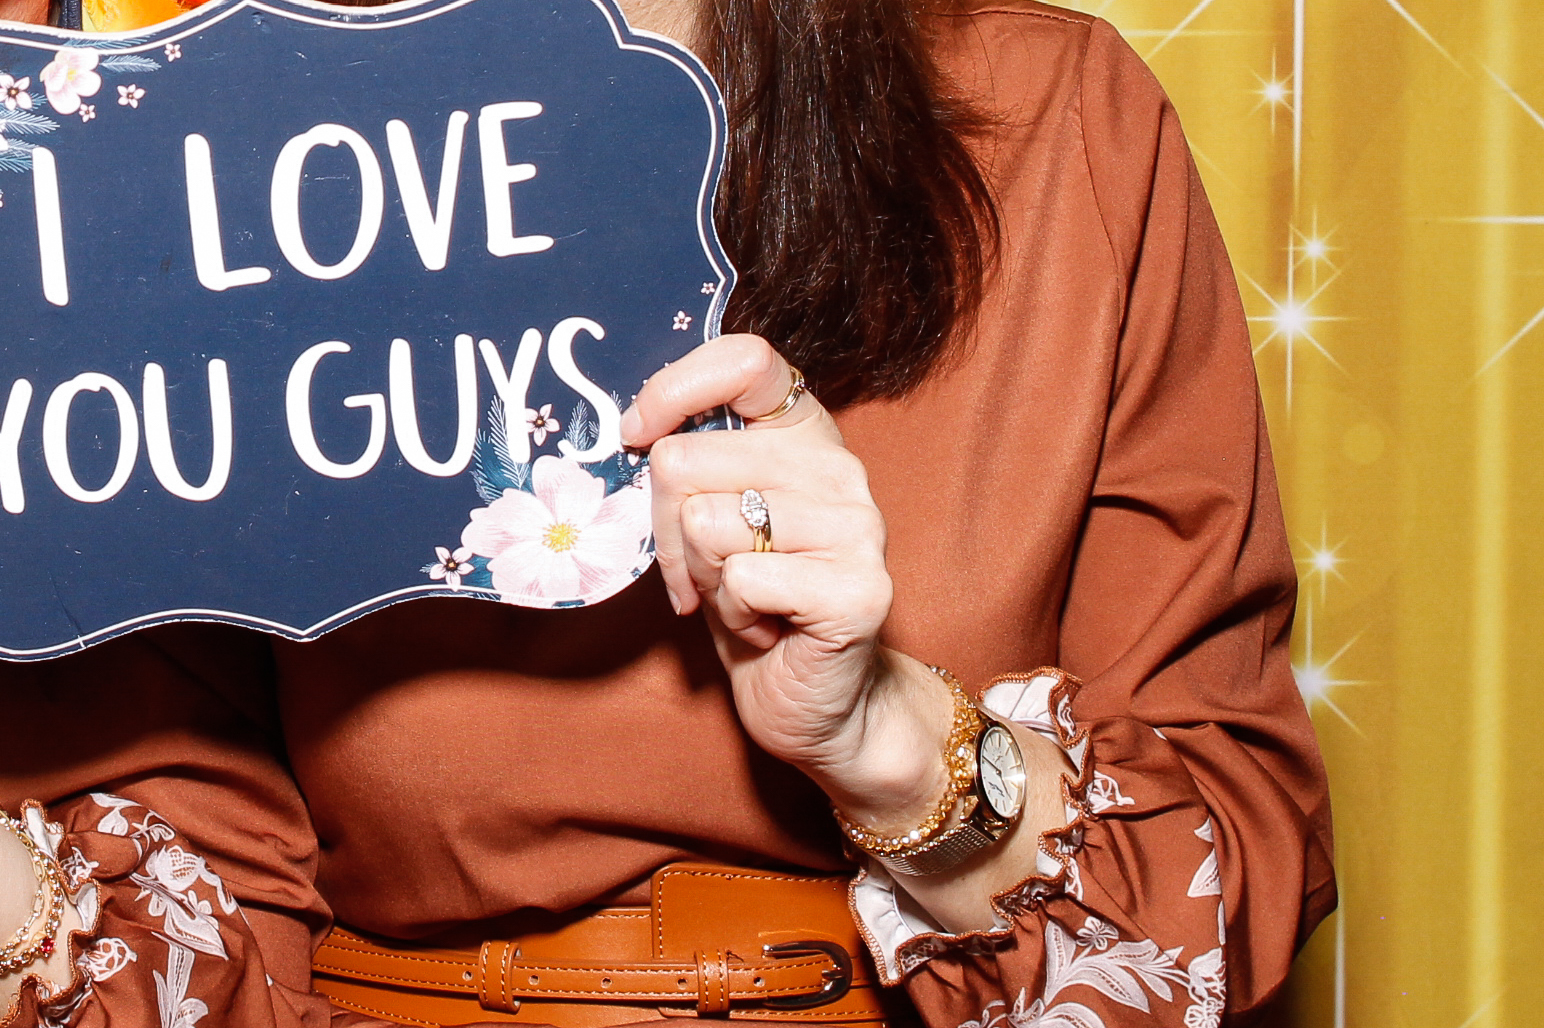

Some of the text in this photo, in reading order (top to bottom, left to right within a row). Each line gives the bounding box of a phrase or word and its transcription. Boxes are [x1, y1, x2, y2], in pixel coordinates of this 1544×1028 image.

[32, 101, 555, 306] I LOVE
[285, 316, 624, 478] GUYS
